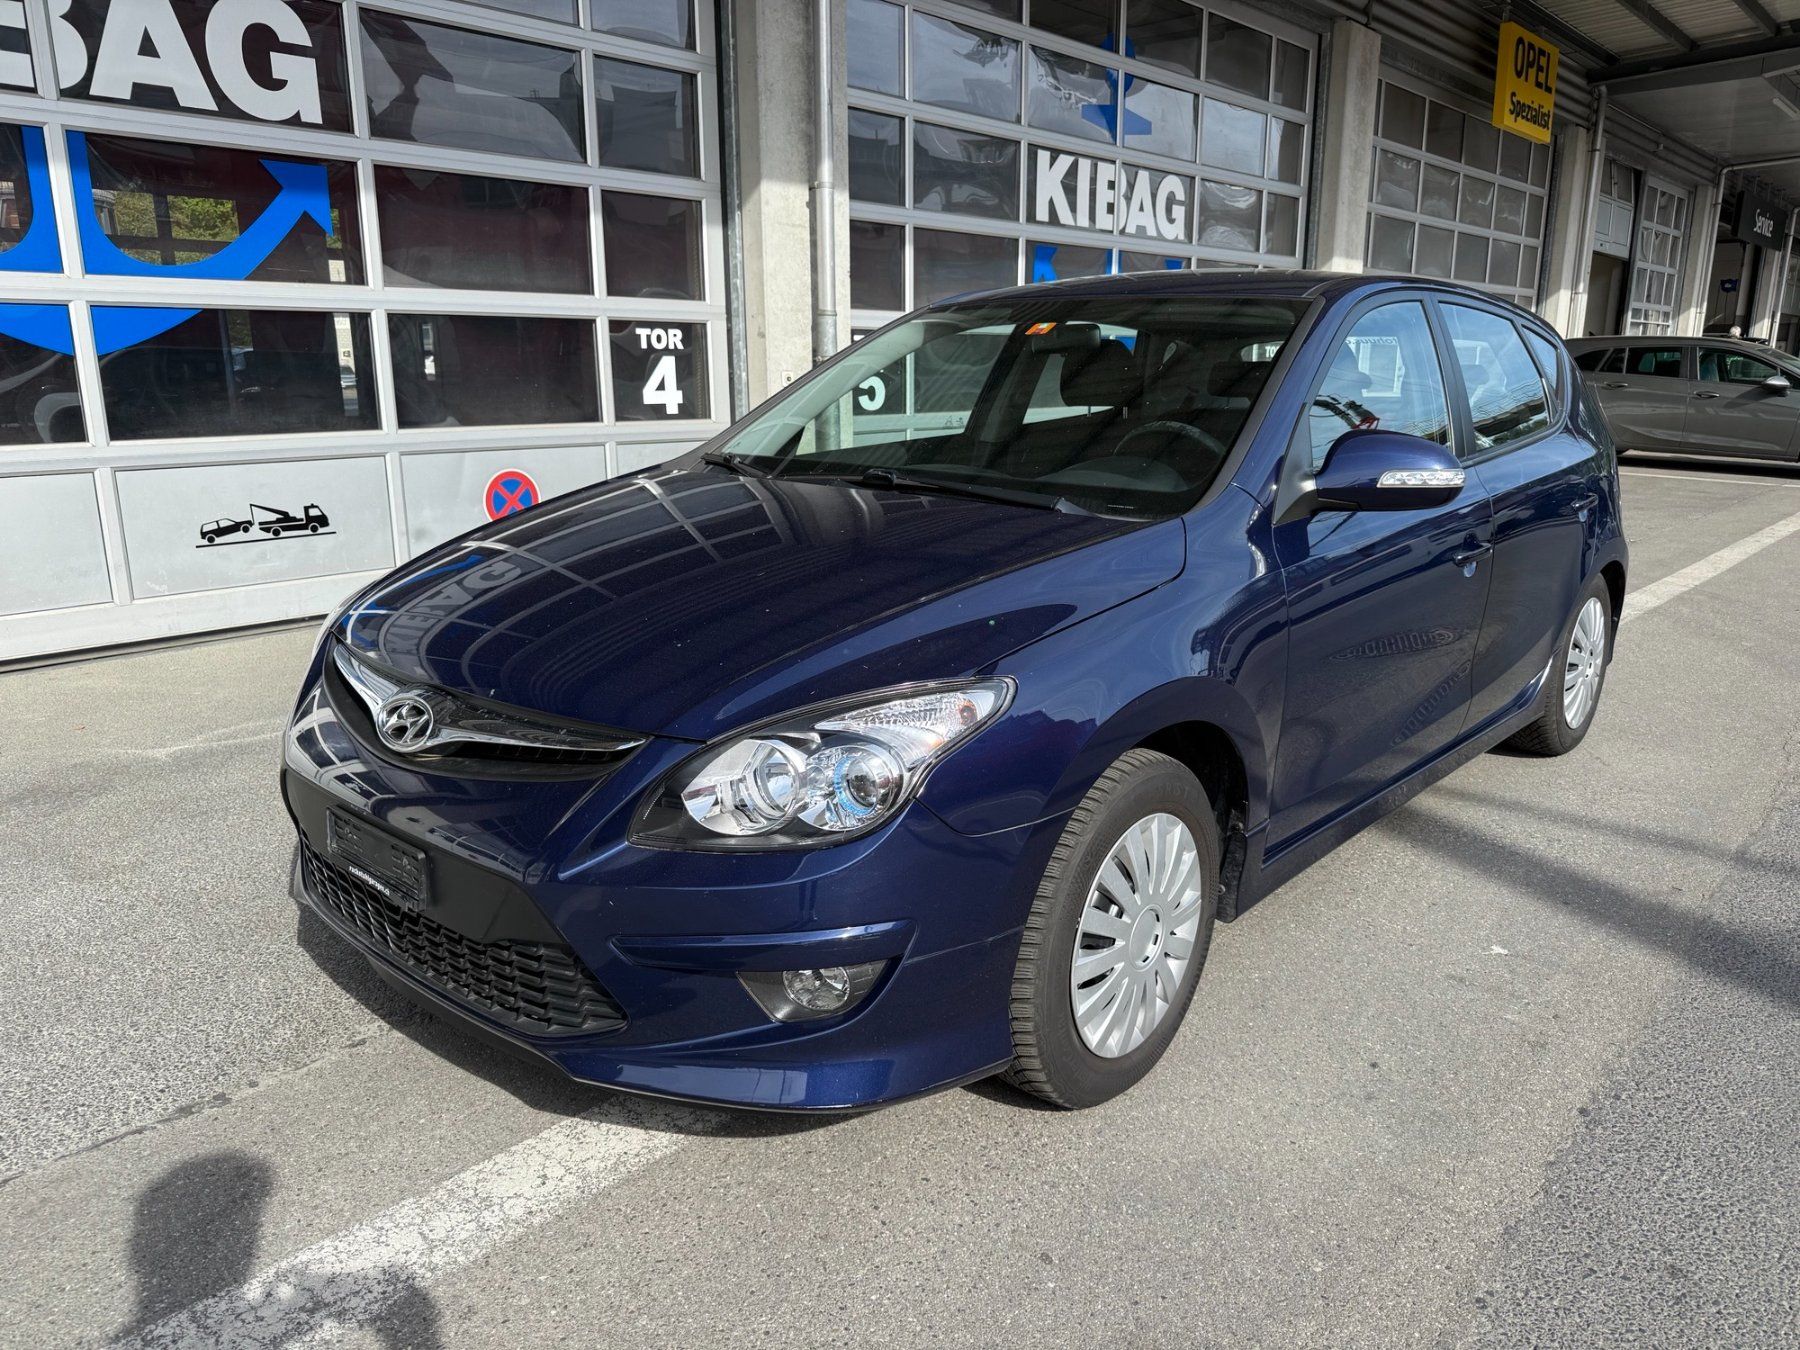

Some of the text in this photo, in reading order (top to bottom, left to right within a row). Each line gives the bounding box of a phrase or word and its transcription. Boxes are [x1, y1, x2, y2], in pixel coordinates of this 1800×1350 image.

[1514, 36, 1553, 94] OPEL
[1509, 92, 1551, 130] Spezialist
[1035, 149, 1186, 240] KIBAG
[1753, 208, 1773, 238] Service
[635, 327, 684, 350] TOR
[642, 355, 683, 415] 4
